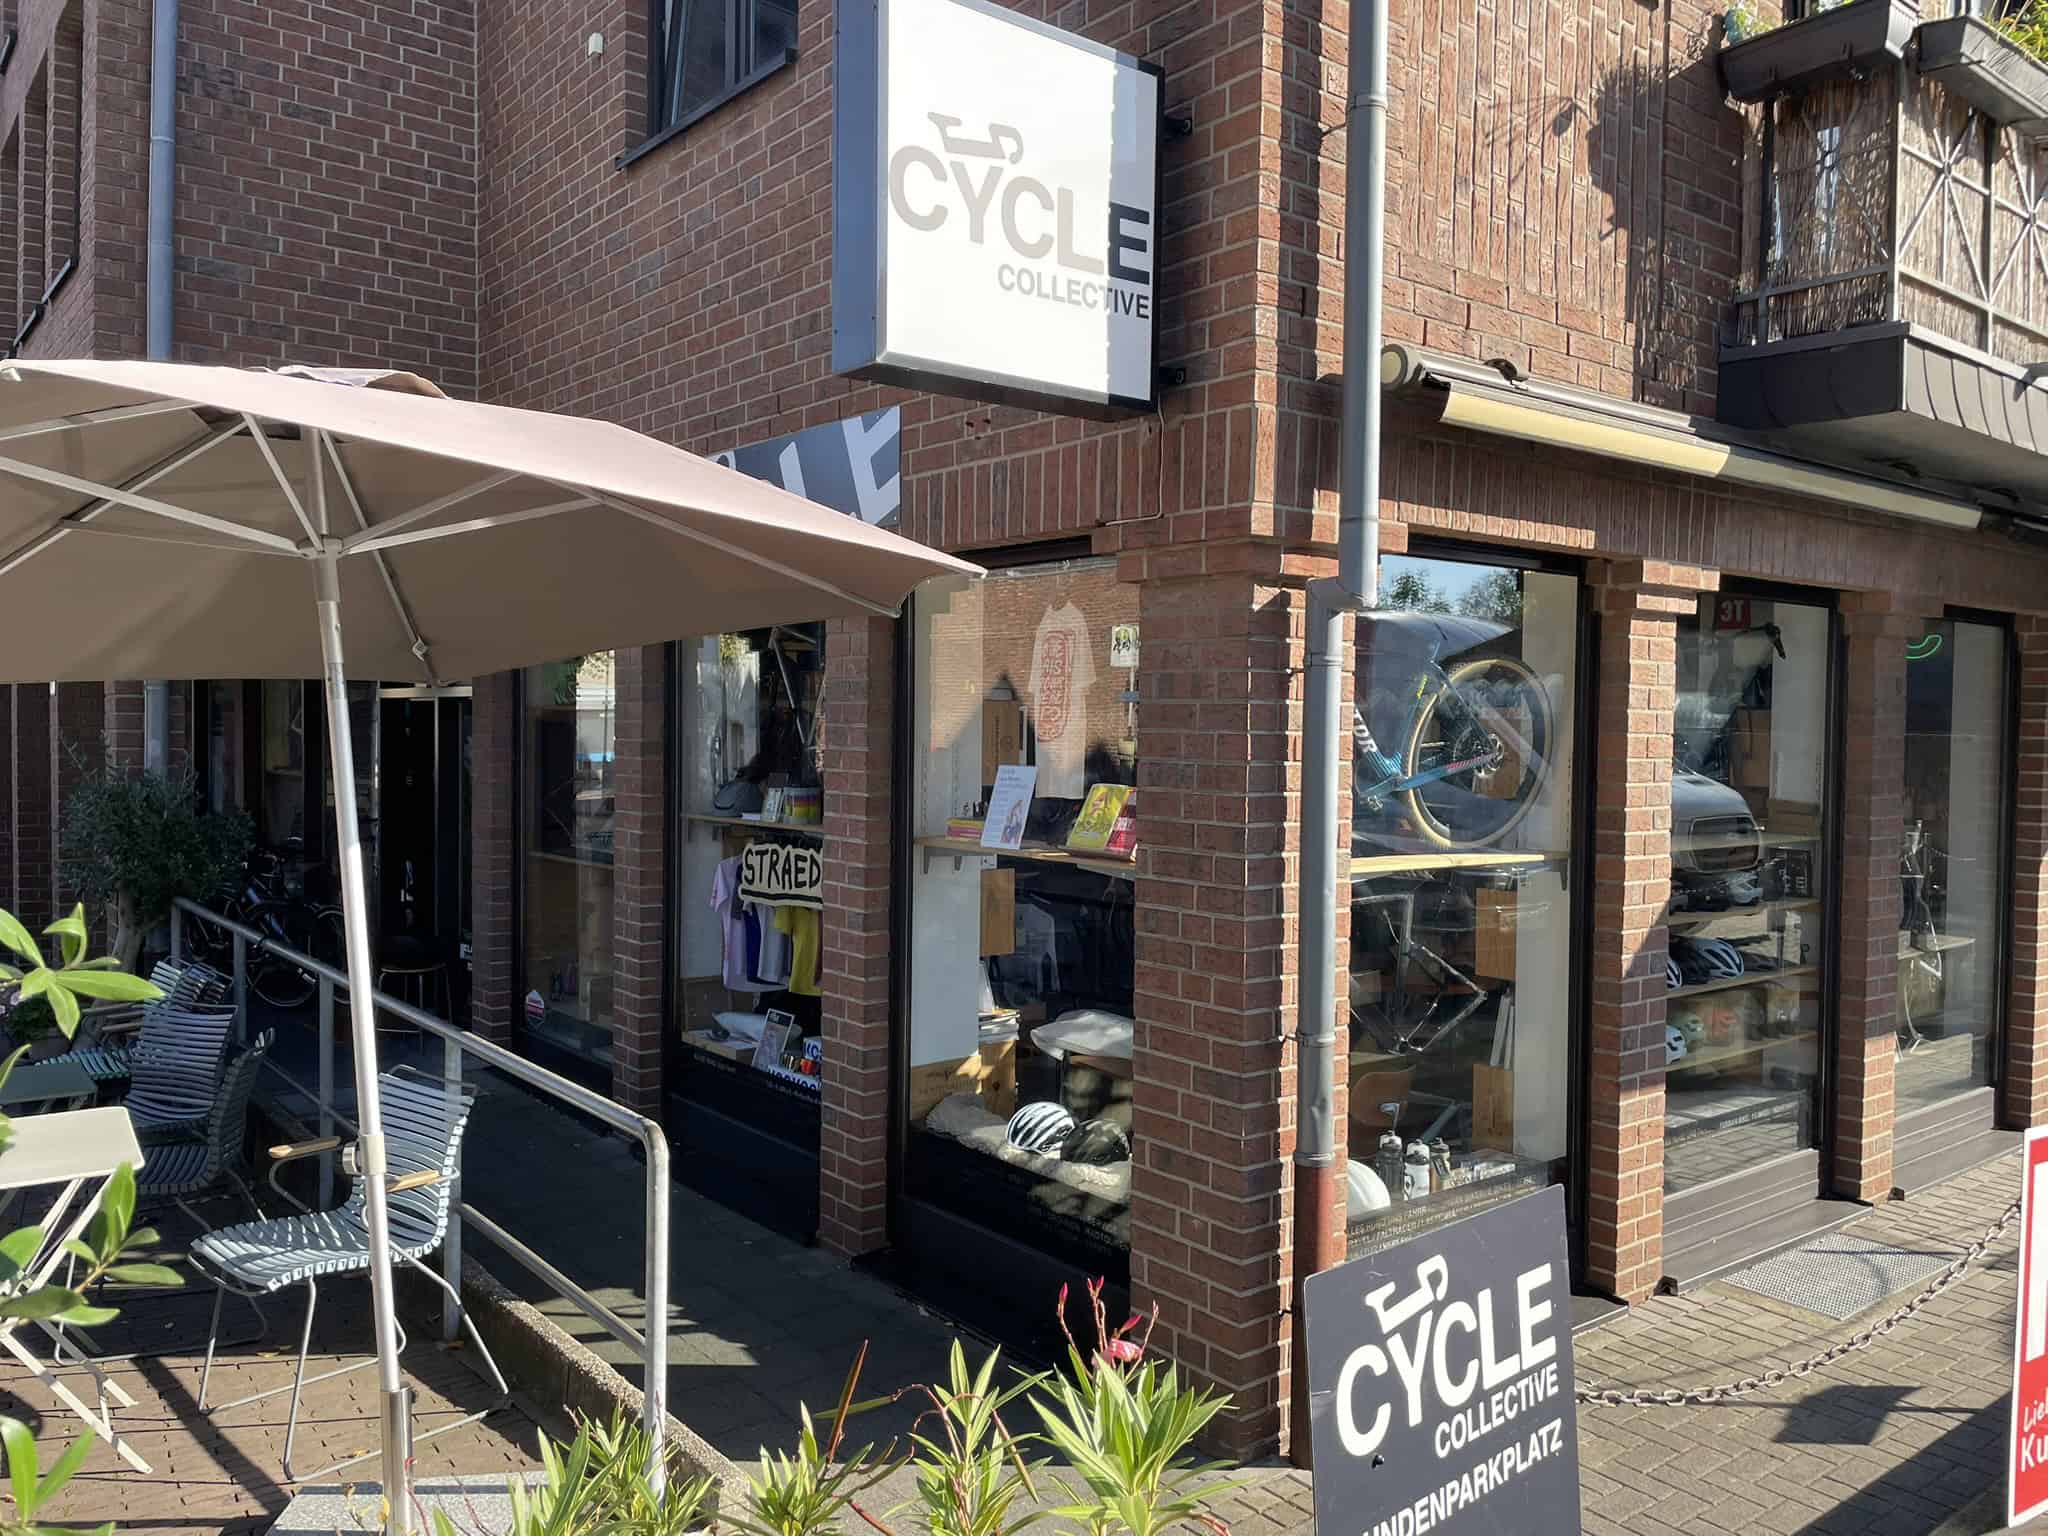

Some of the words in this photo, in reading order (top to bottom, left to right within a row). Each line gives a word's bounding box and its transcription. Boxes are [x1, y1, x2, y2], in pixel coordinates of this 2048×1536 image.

[889, 145, 1150, 286] CYCLE
[998, 263, 1149, 319] COLLECTIVE
[1336, 1262, 1556, 1456] CYCLE
[1435, 1362, 1559, 1458] COLLECTIVE
